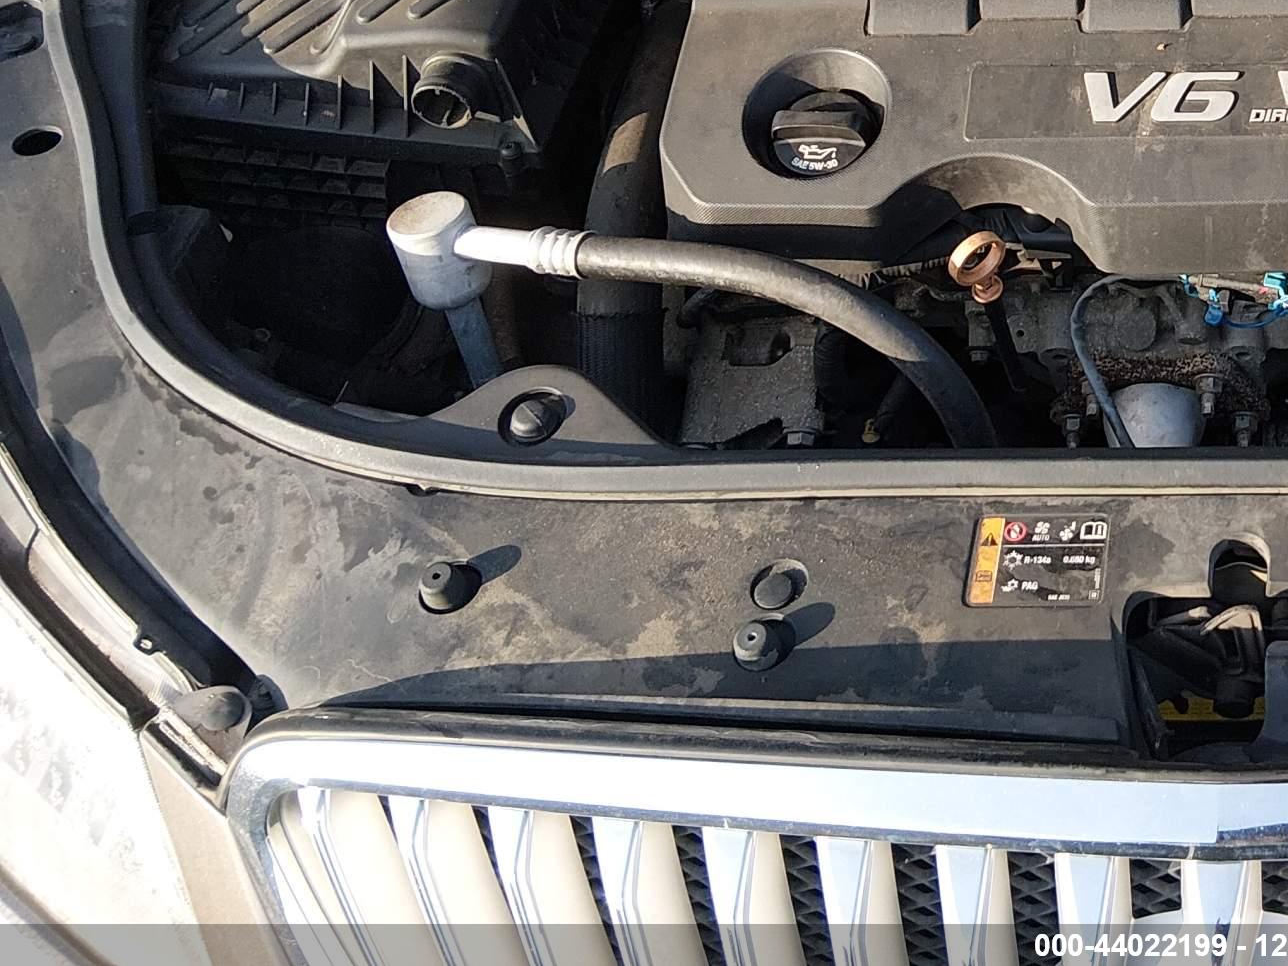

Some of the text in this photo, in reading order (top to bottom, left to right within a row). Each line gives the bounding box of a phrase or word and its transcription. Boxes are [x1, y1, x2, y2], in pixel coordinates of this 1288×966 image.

[1084, 71, 1238, 122] V6
[792, 156, 839, 171] SAE 5W-30
[1032, 534, 1050, 542] AUTO
[1085, 555, 1096, 566] kg
[1021, 581, 1039, 592] PAG
